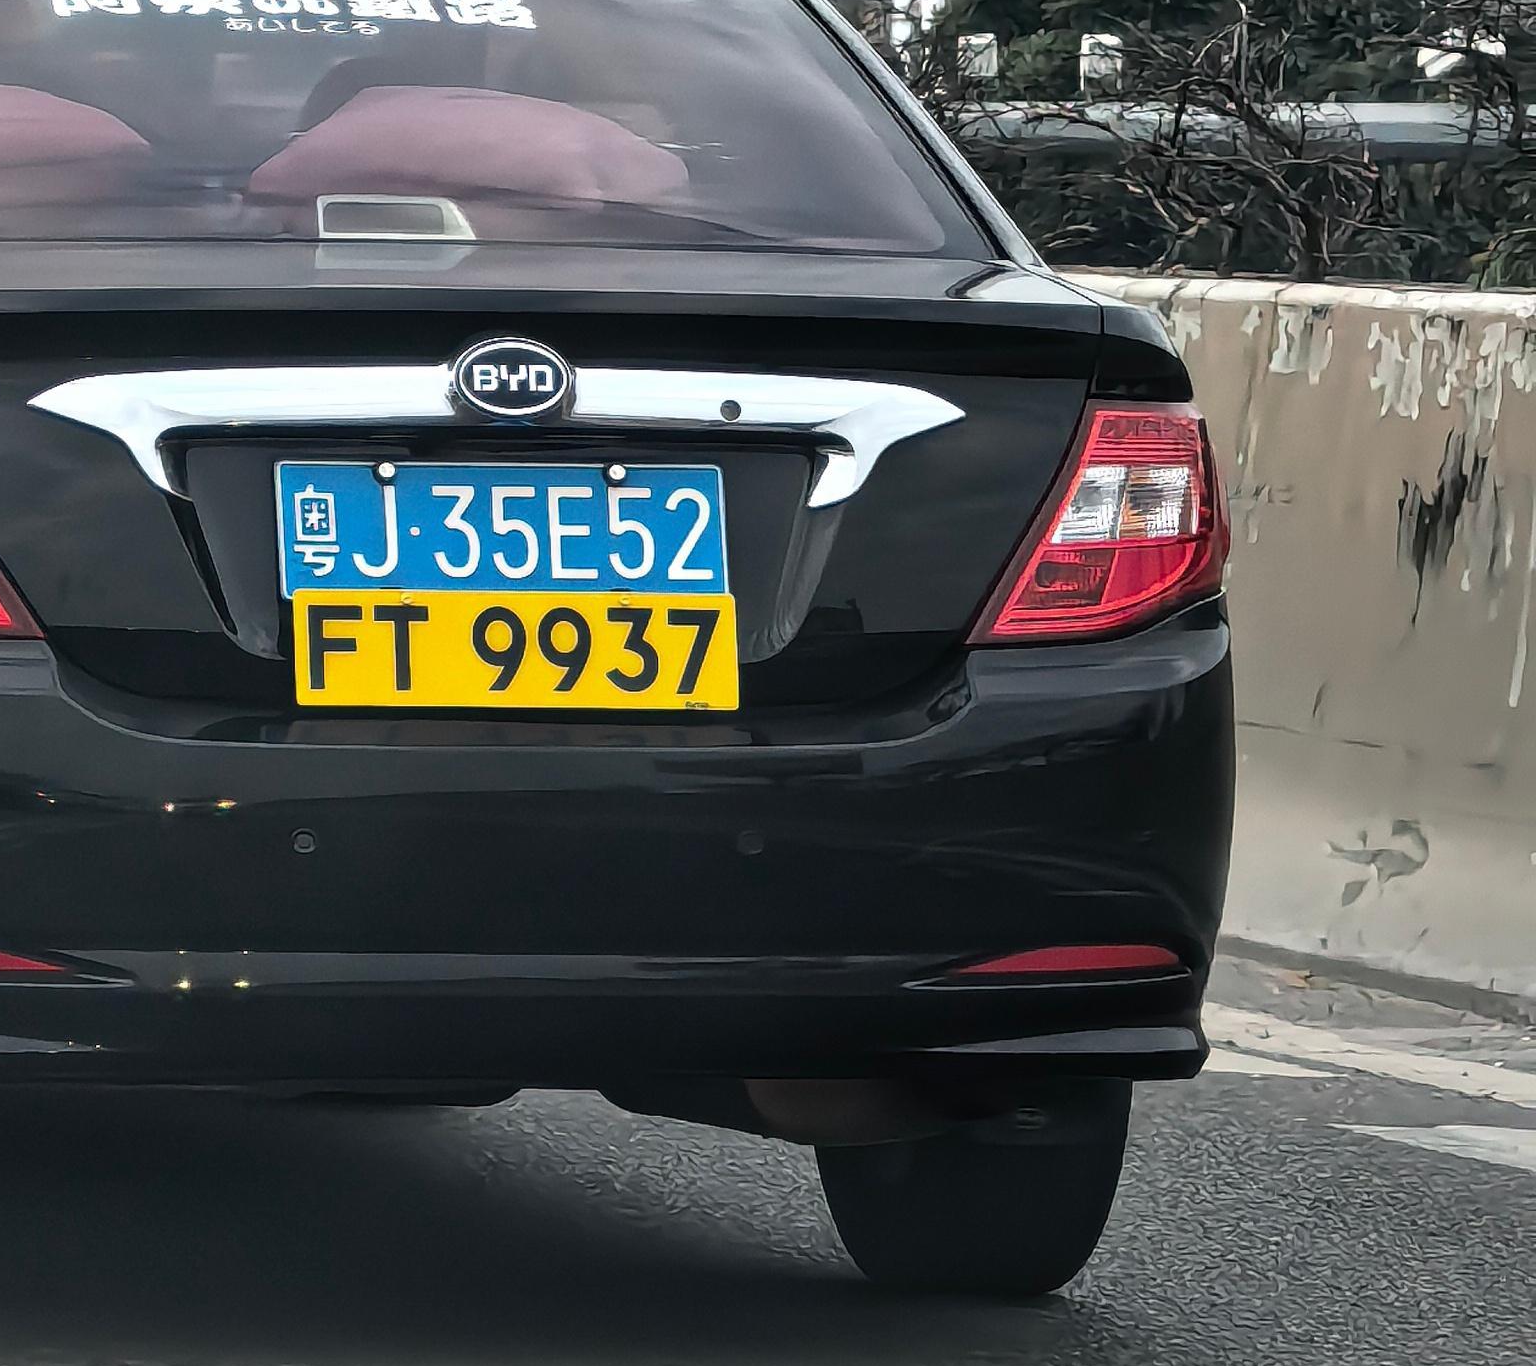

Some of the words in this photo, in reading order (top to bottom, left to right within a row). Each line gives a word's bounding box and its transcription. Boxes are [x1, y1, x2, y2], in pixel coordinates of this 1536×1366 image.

[222, 16, 381, 35] あいしてる
[472, 363, 555, 392] BYD
[307, 604, 430, 691] FT
[471, 605, 721, 695] 9937
